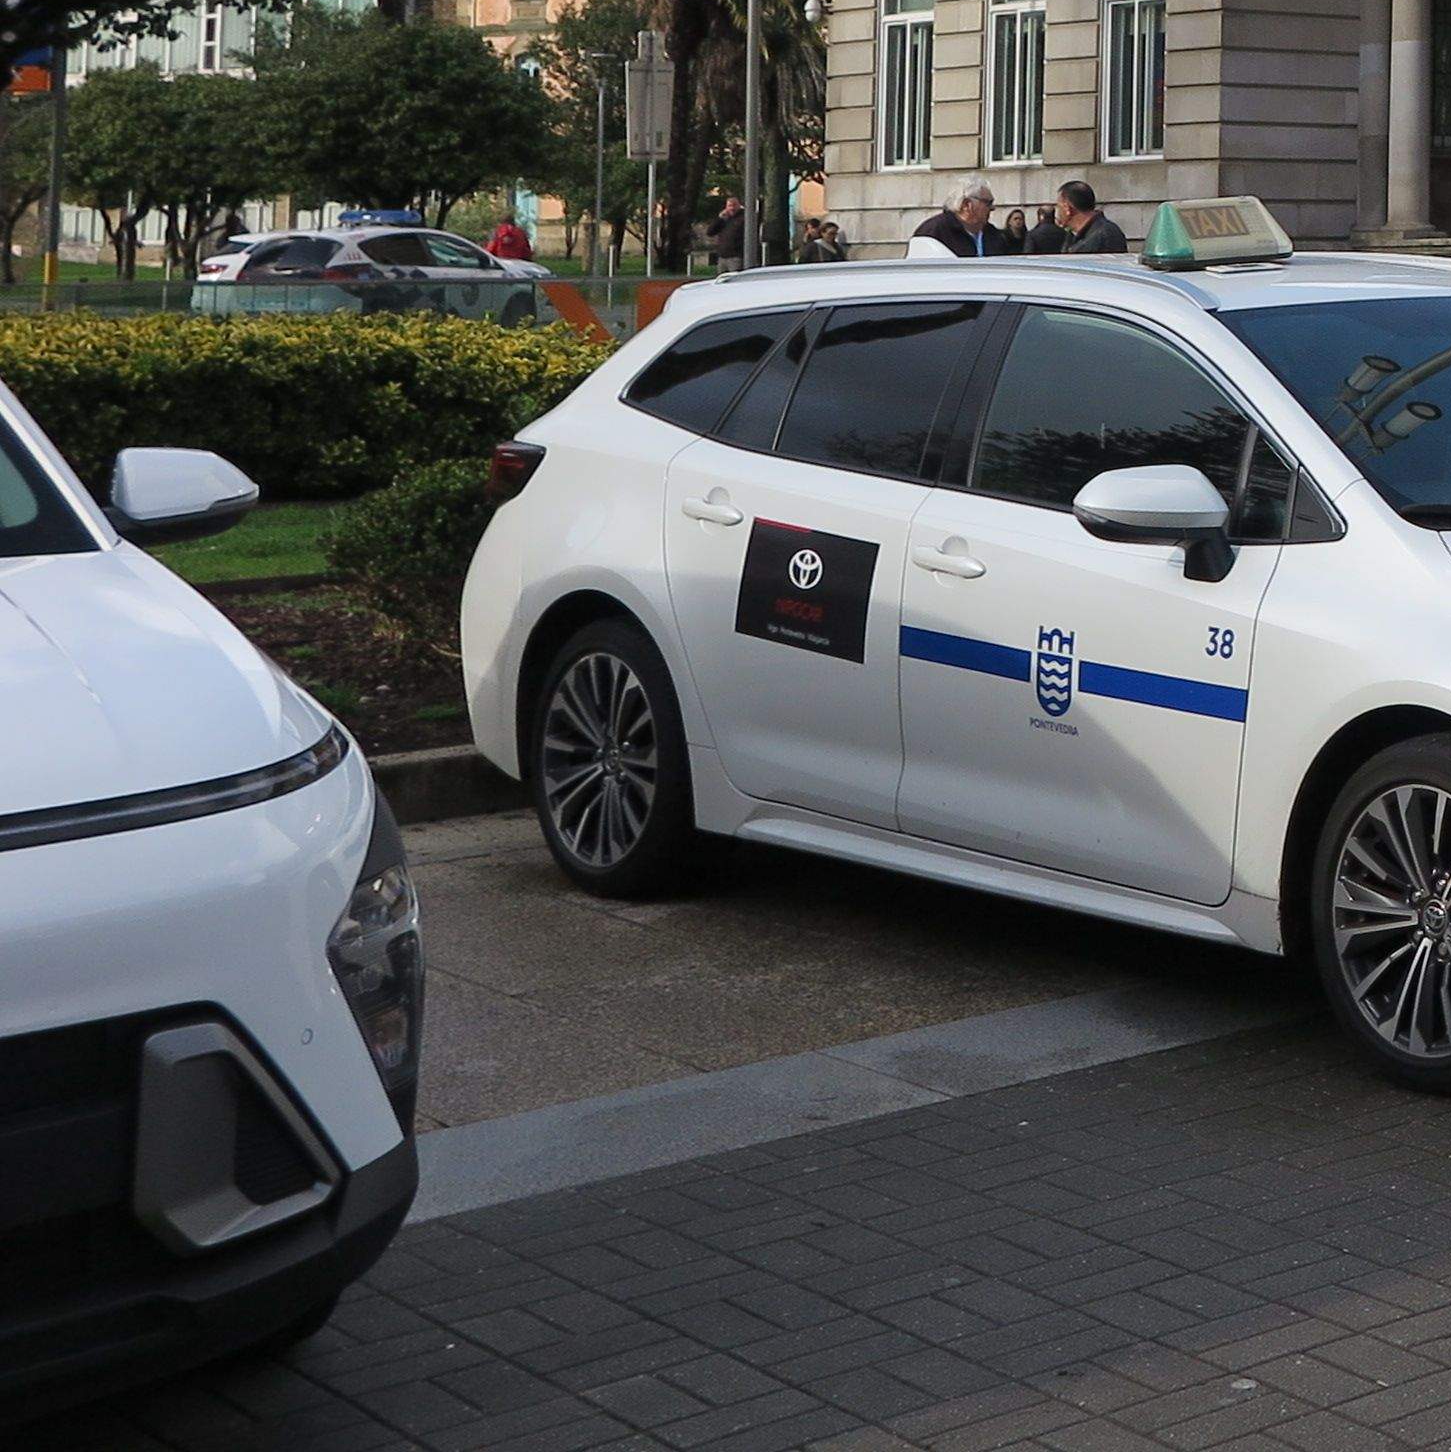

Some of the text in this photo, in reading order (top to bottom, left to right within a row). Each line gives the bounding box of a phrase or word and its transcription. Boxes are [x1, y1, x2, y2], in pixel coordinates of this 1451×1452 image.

[1179, 207, 1247, 239] TAXI
[1204, 625, 1236, 660] 38
[1028, 716, 1080, 737] PONTEVEDRA
